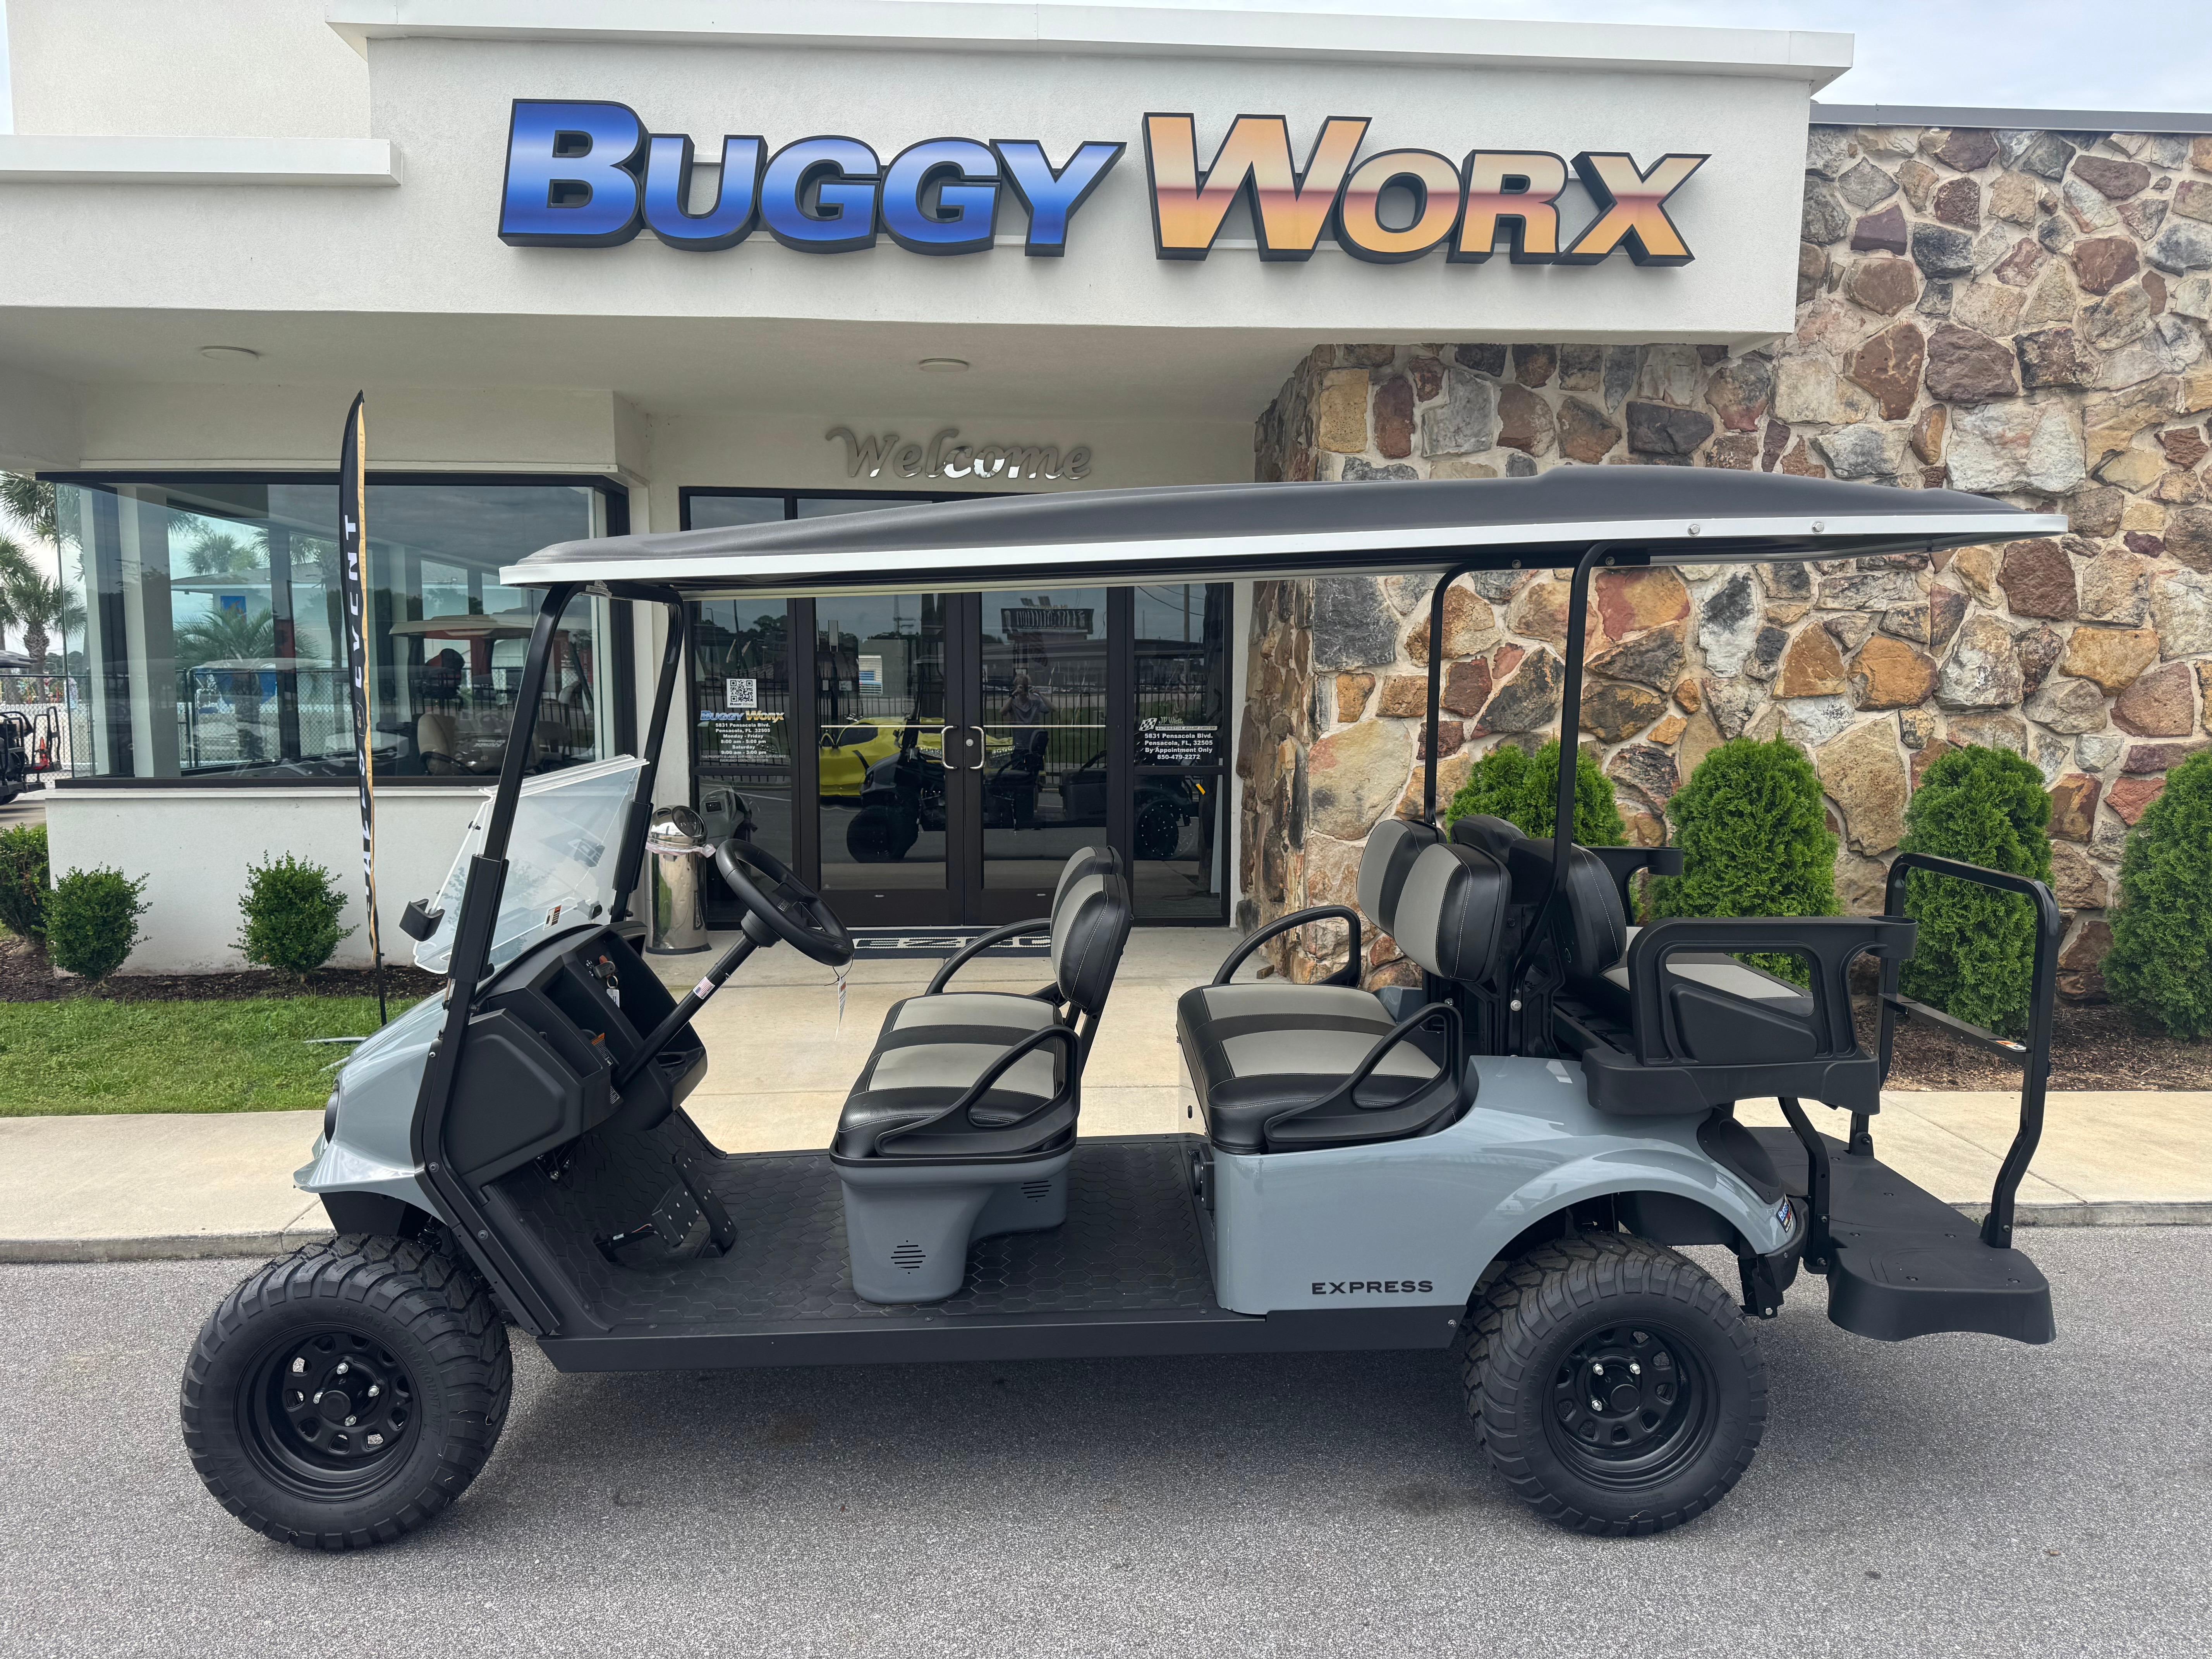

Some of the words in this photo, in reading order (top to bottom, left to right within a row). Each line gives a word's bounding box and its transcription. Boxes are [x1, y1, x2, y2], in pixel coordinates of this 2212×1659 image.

[498, 98, 1127, 257] BUGGY
[1142, 112, 1711, 267] WORX
[825, 427, 1091, 479] Welcome
[700, 710, 744, 721] BUGGY
[745, 710, 785, 723] WORX
[1312, 1280, 1433, 1295] EXPRESS
